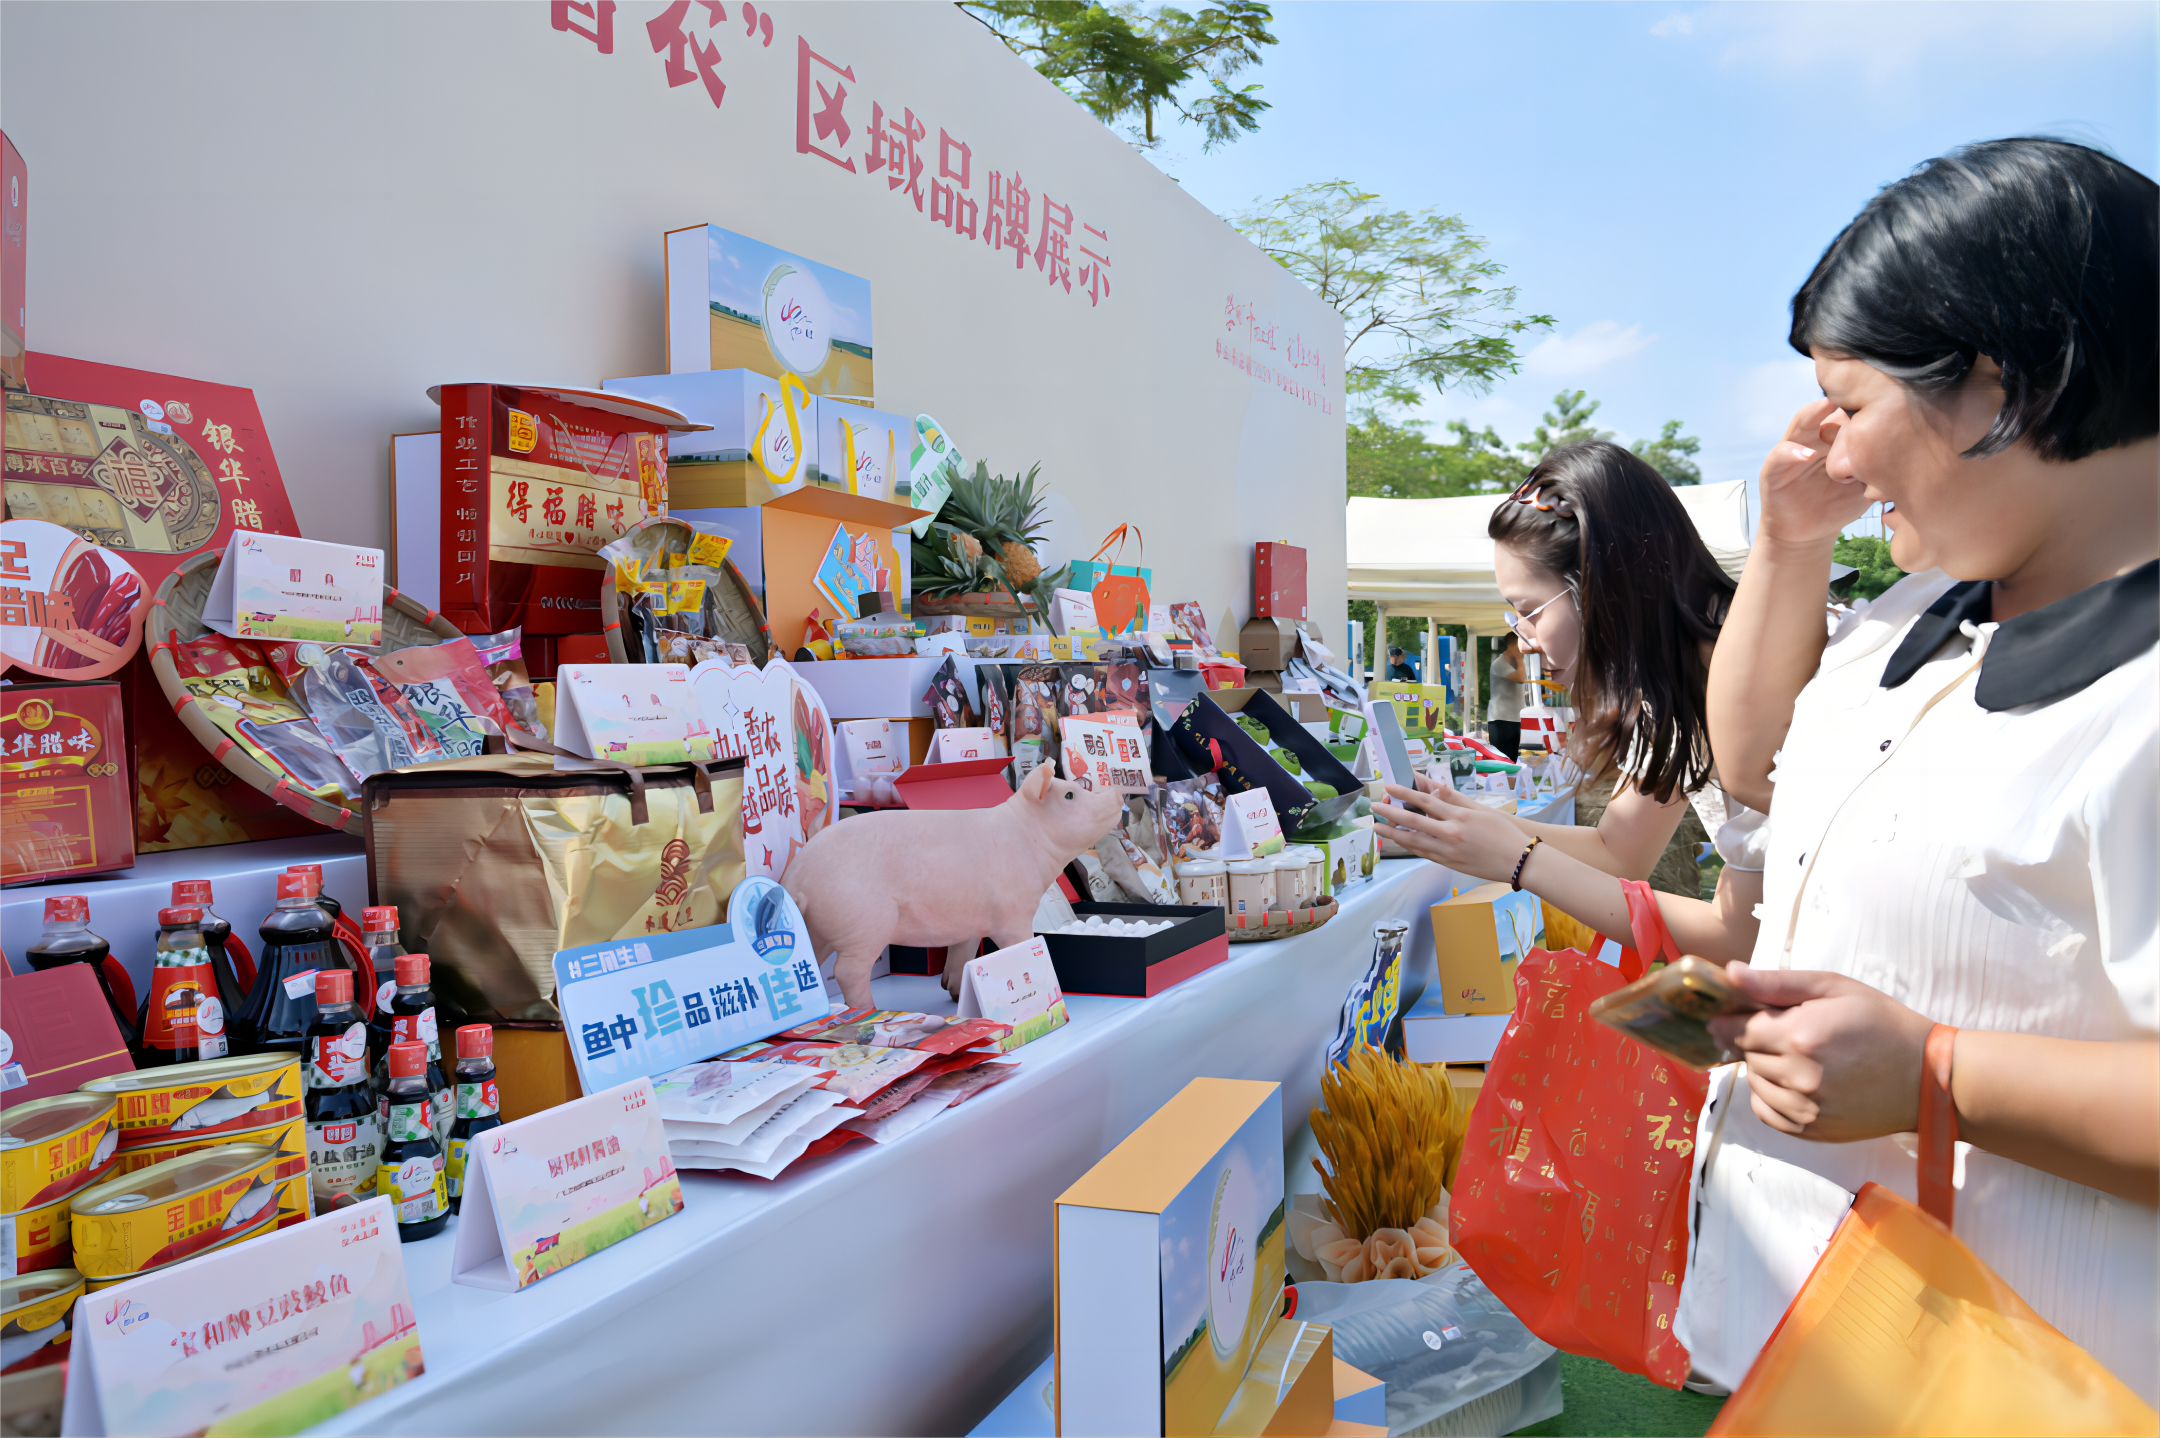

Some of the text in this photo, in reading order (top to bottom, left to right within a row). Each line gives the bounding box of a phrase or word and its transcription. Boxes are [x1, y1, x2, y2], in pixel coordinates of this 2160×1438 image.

[0, 728, 96, 758] 华腊味
[581, 959, 819, 1061] 鱼中珍品滋补佳选
